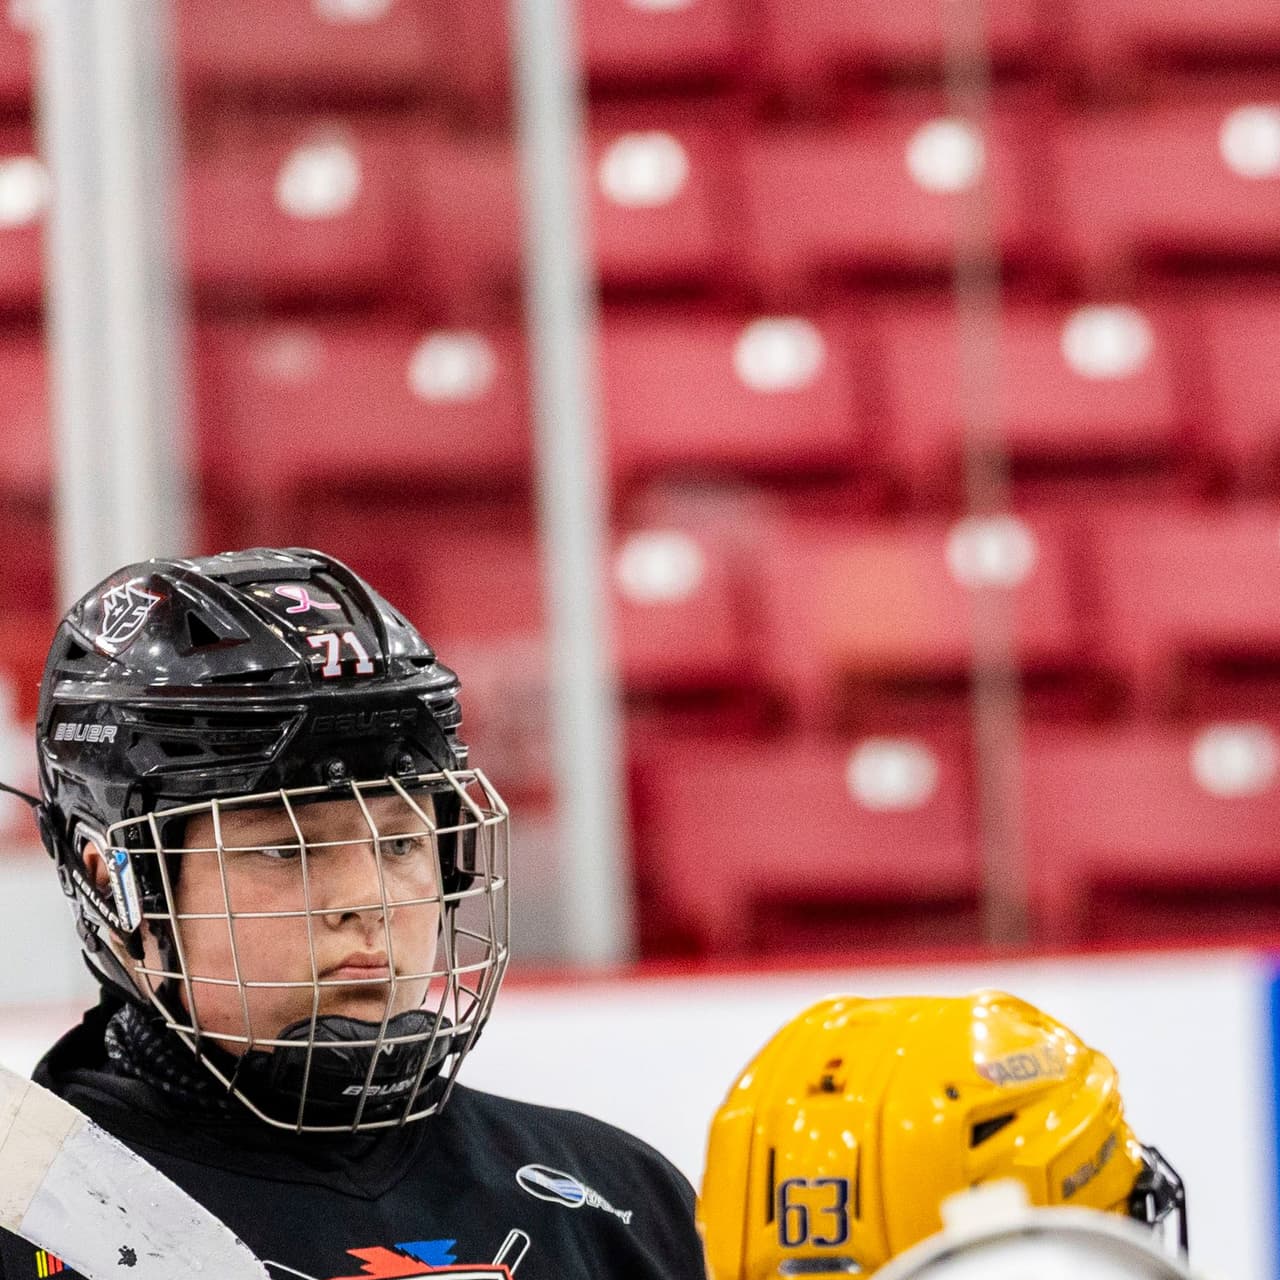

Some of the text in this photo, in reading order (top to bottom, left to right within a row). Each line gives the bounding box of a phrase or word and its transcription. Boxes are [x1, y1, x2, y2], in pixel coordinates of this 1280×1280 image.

[307, 631, 375, 678] 71
[54, 721, 118, 744] BAUER
[777, 1179, 849, 1247] 63
